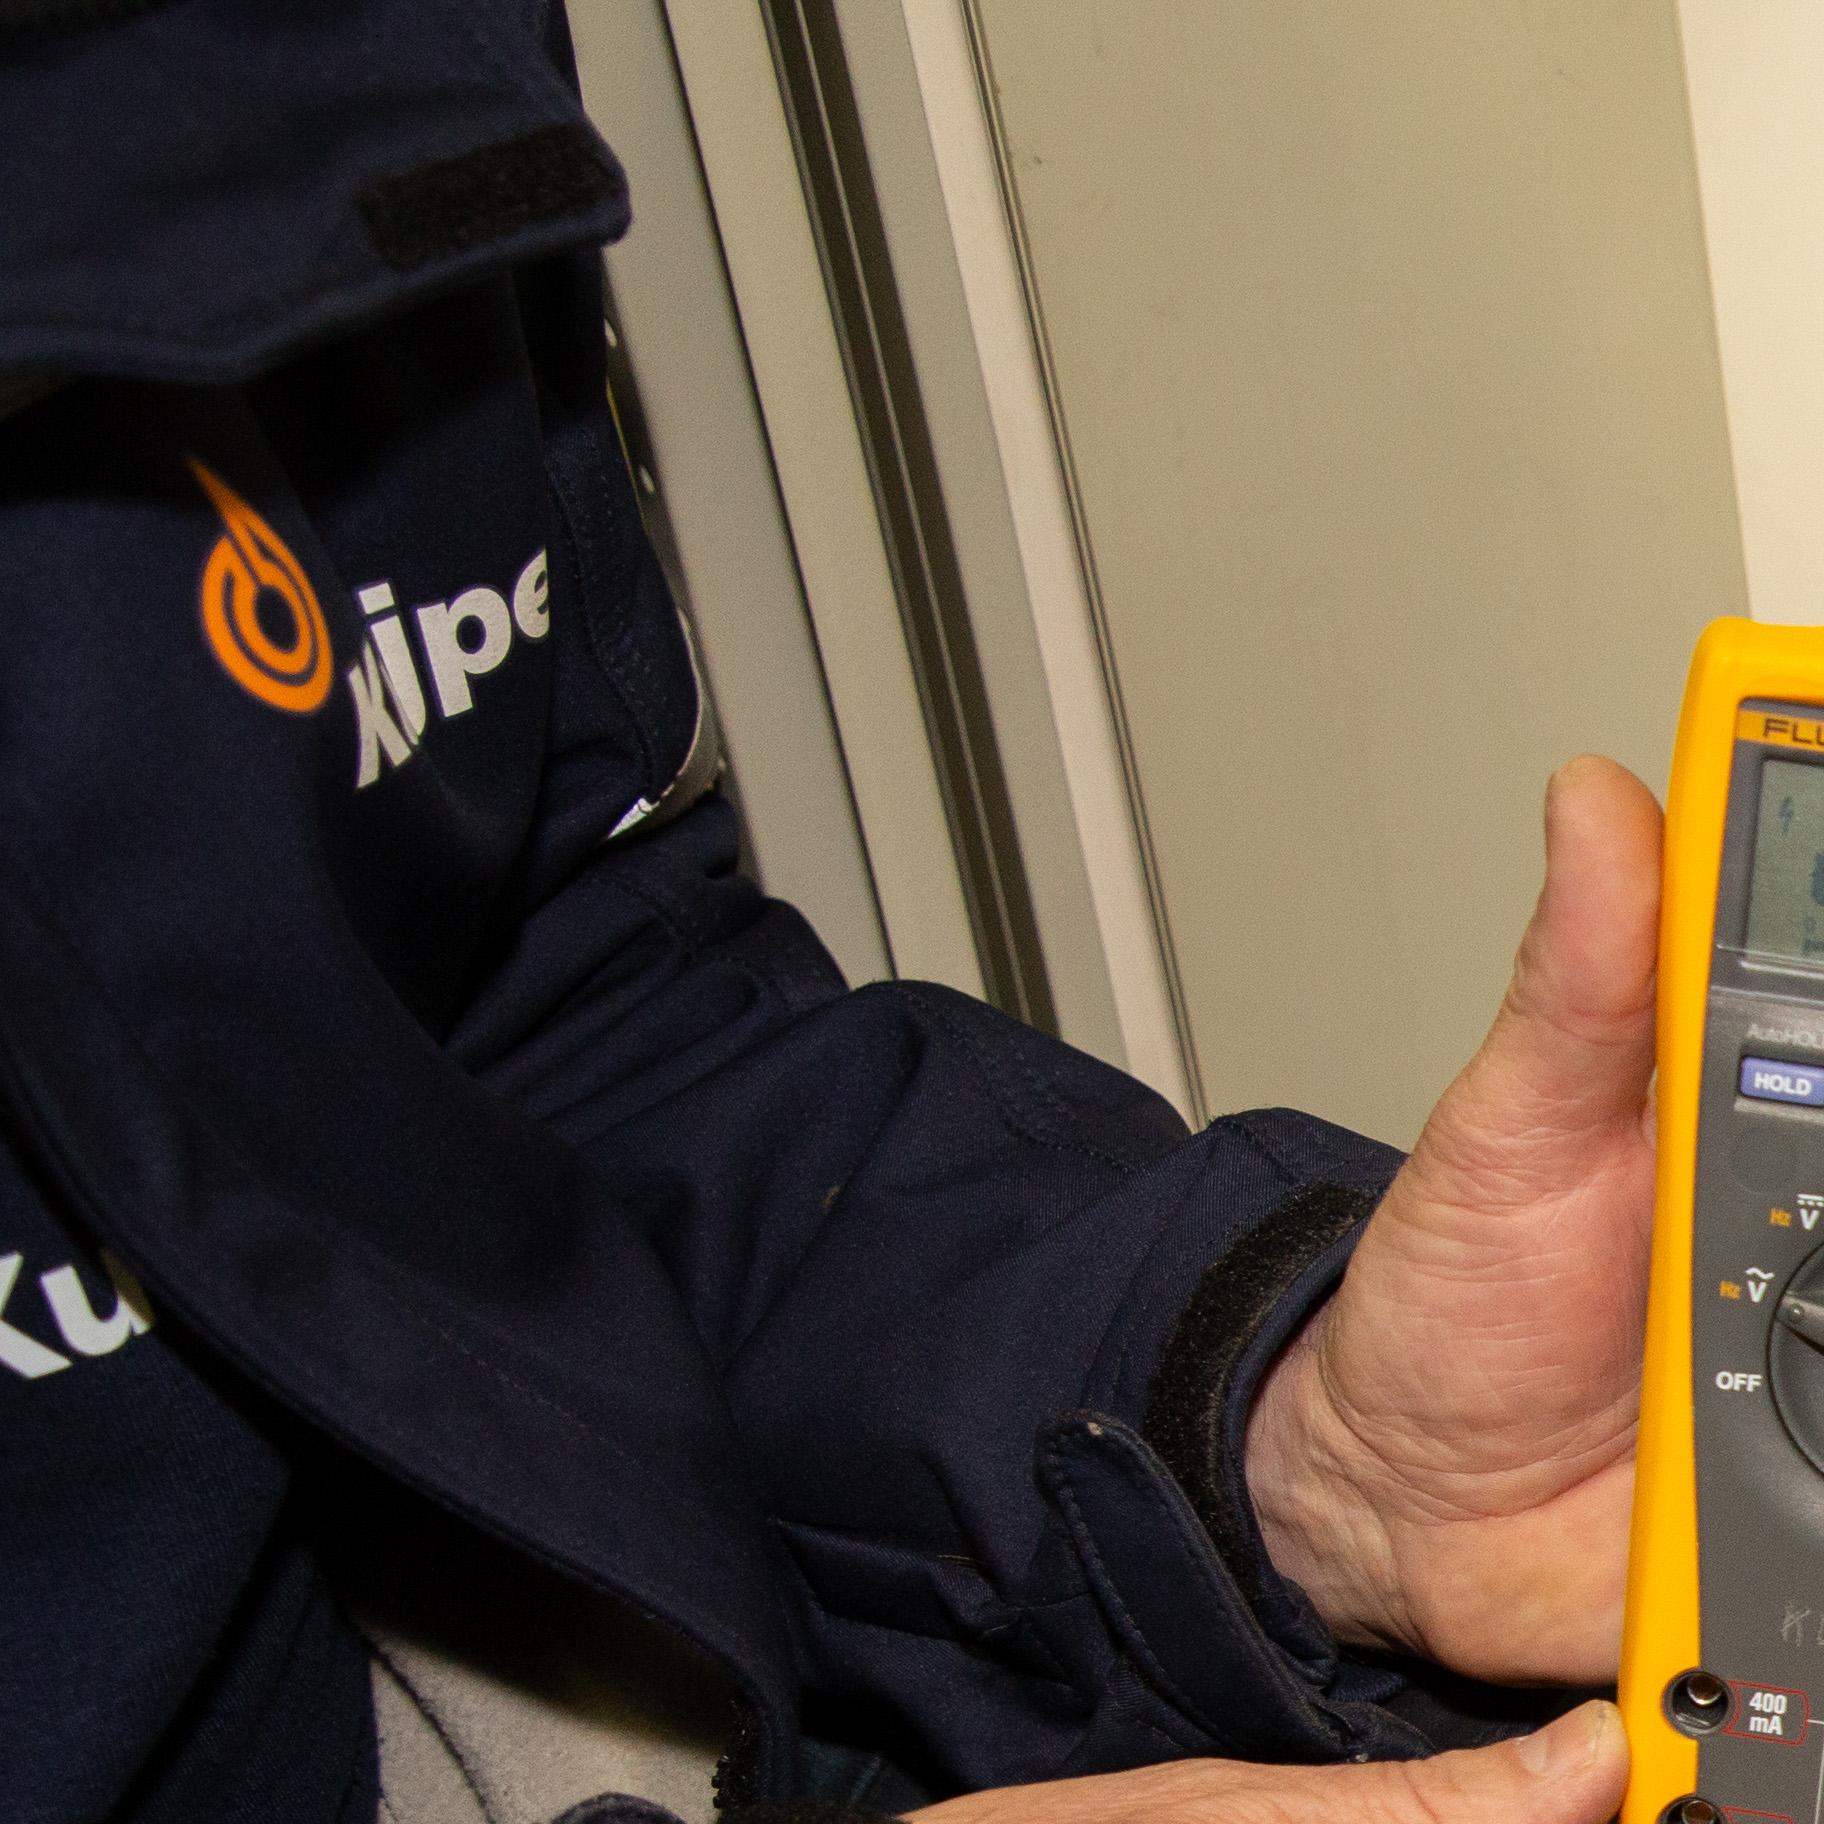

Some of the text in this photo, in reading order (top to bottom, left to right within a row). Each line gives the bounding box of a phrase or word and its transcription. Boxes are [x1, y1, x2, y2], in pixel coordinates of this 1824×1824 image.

[1752, 1072, 1811, 1097] HOLD
[1769, 1207, 1820, 1230] Hz V
[1719, 1279, 1768, 1303] Hz V
[1715, 1371, 1761, 1392] OFF
[1749, 1691, 1787, 1715] 400
[1748, 1714, 1783, 1738] mA
